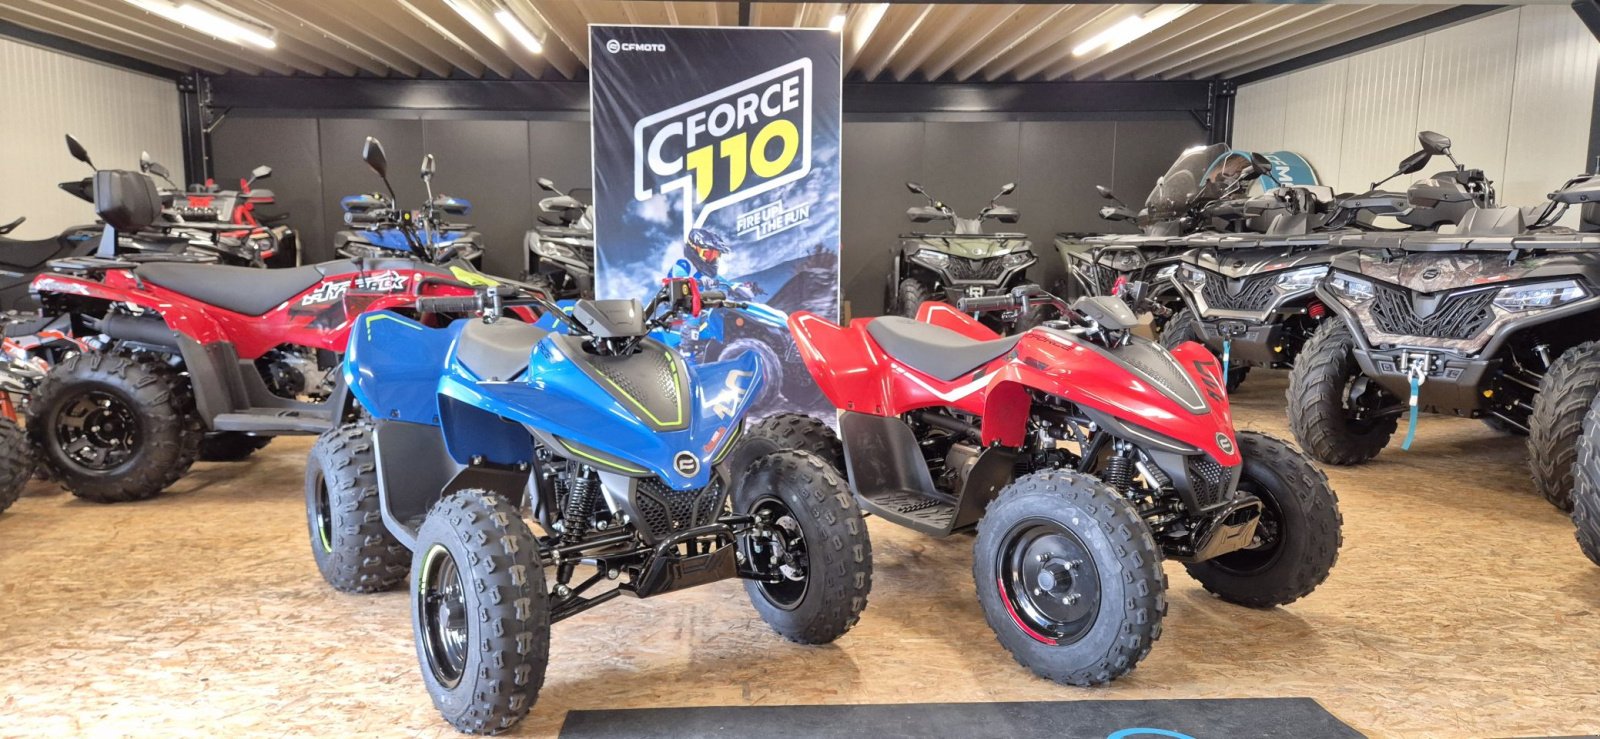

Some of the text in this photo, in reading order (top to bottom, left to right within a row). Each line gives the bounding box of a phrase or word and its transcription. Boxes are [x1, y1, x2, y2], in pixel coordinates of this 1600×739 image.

[621, 42, 666, 52] CFMOTO
[647, 75, 800, 176] CFORCE
[686, 118, 800, 205] 110
[736, 212, 761, 232] FIRE
[760, 205, 810, 235] THE FUN
